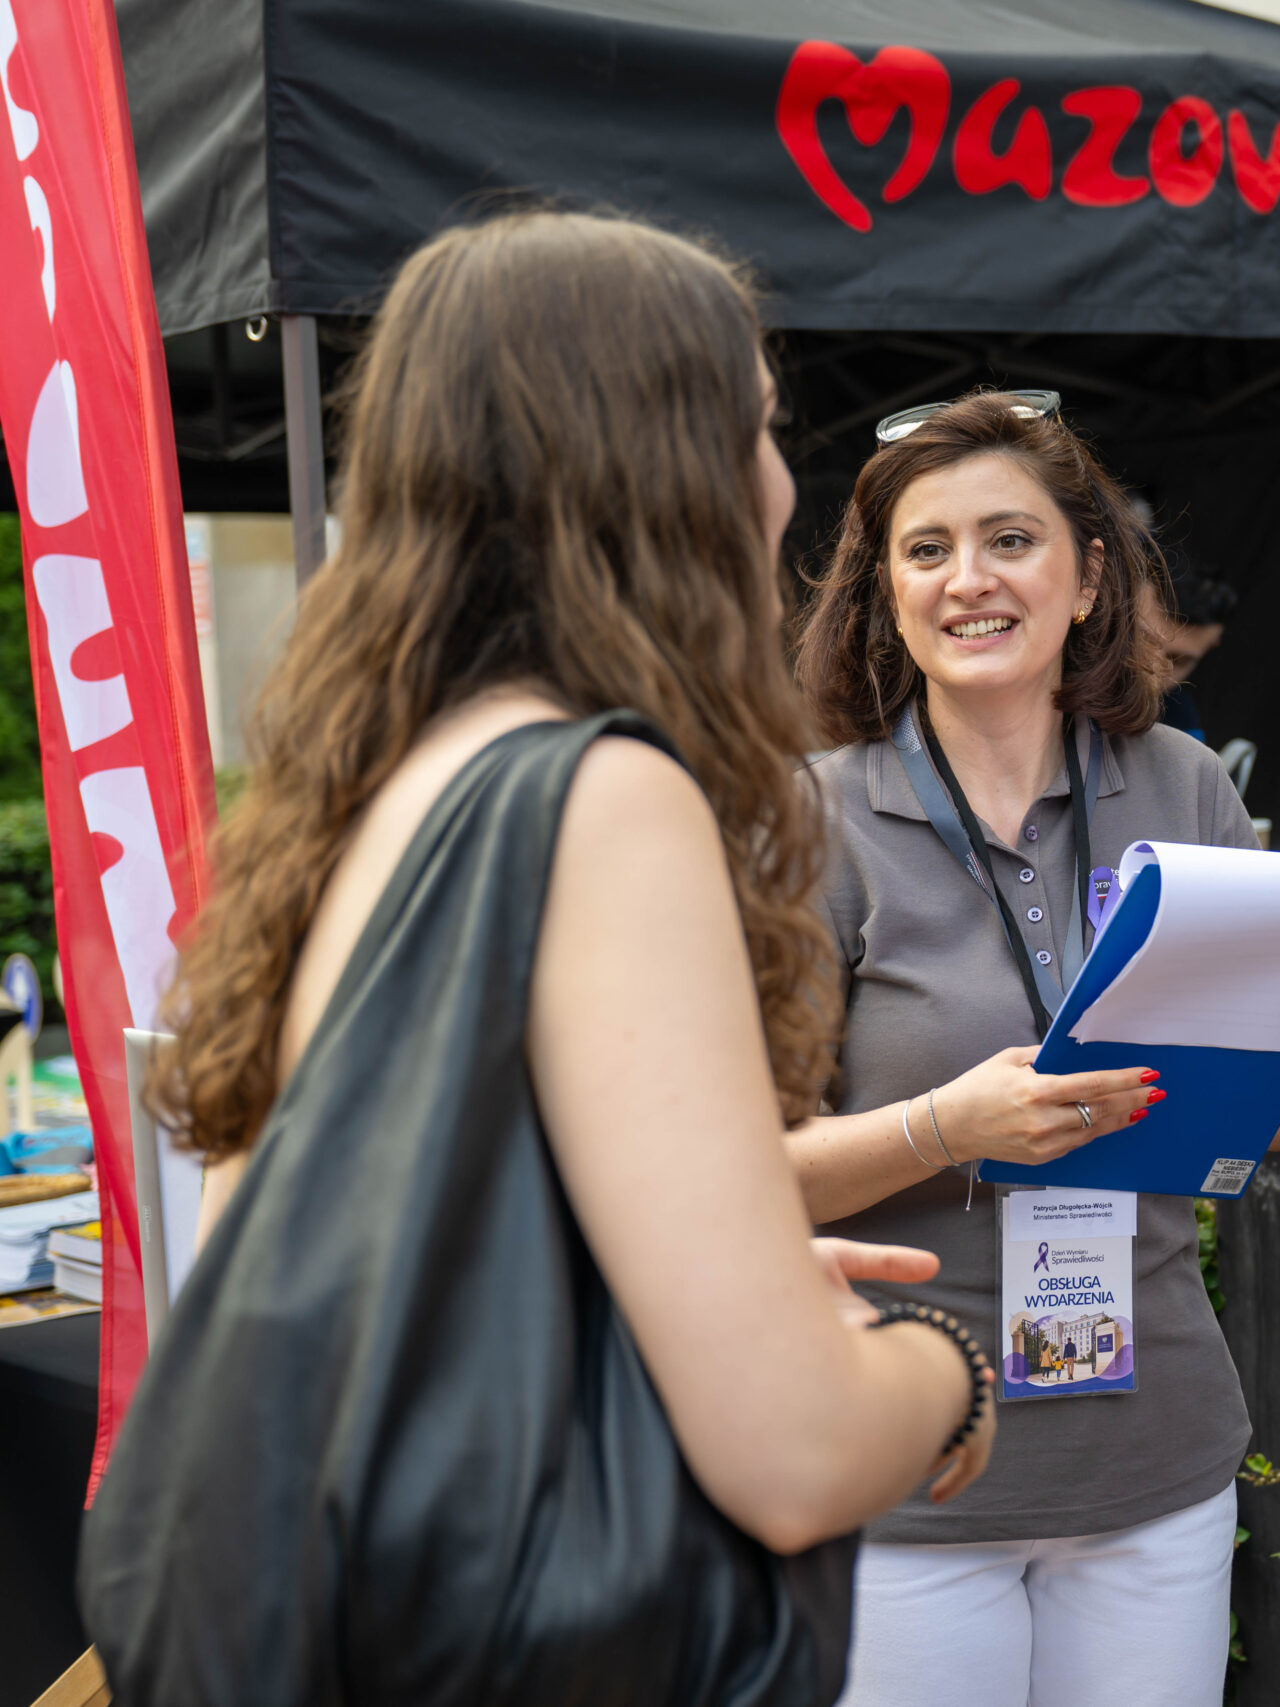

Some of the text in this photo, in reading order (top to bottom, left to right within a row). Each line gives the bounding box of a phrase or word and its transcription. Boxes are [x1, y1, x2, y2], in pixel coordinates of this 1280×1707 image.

[1051, 1254, 1105, 1266] Sprawiedliwości
[1038, 1275, 1101, 1291] OBSŁUGA
[1024, 1290, 1115, 1308] WYDARZENIA
